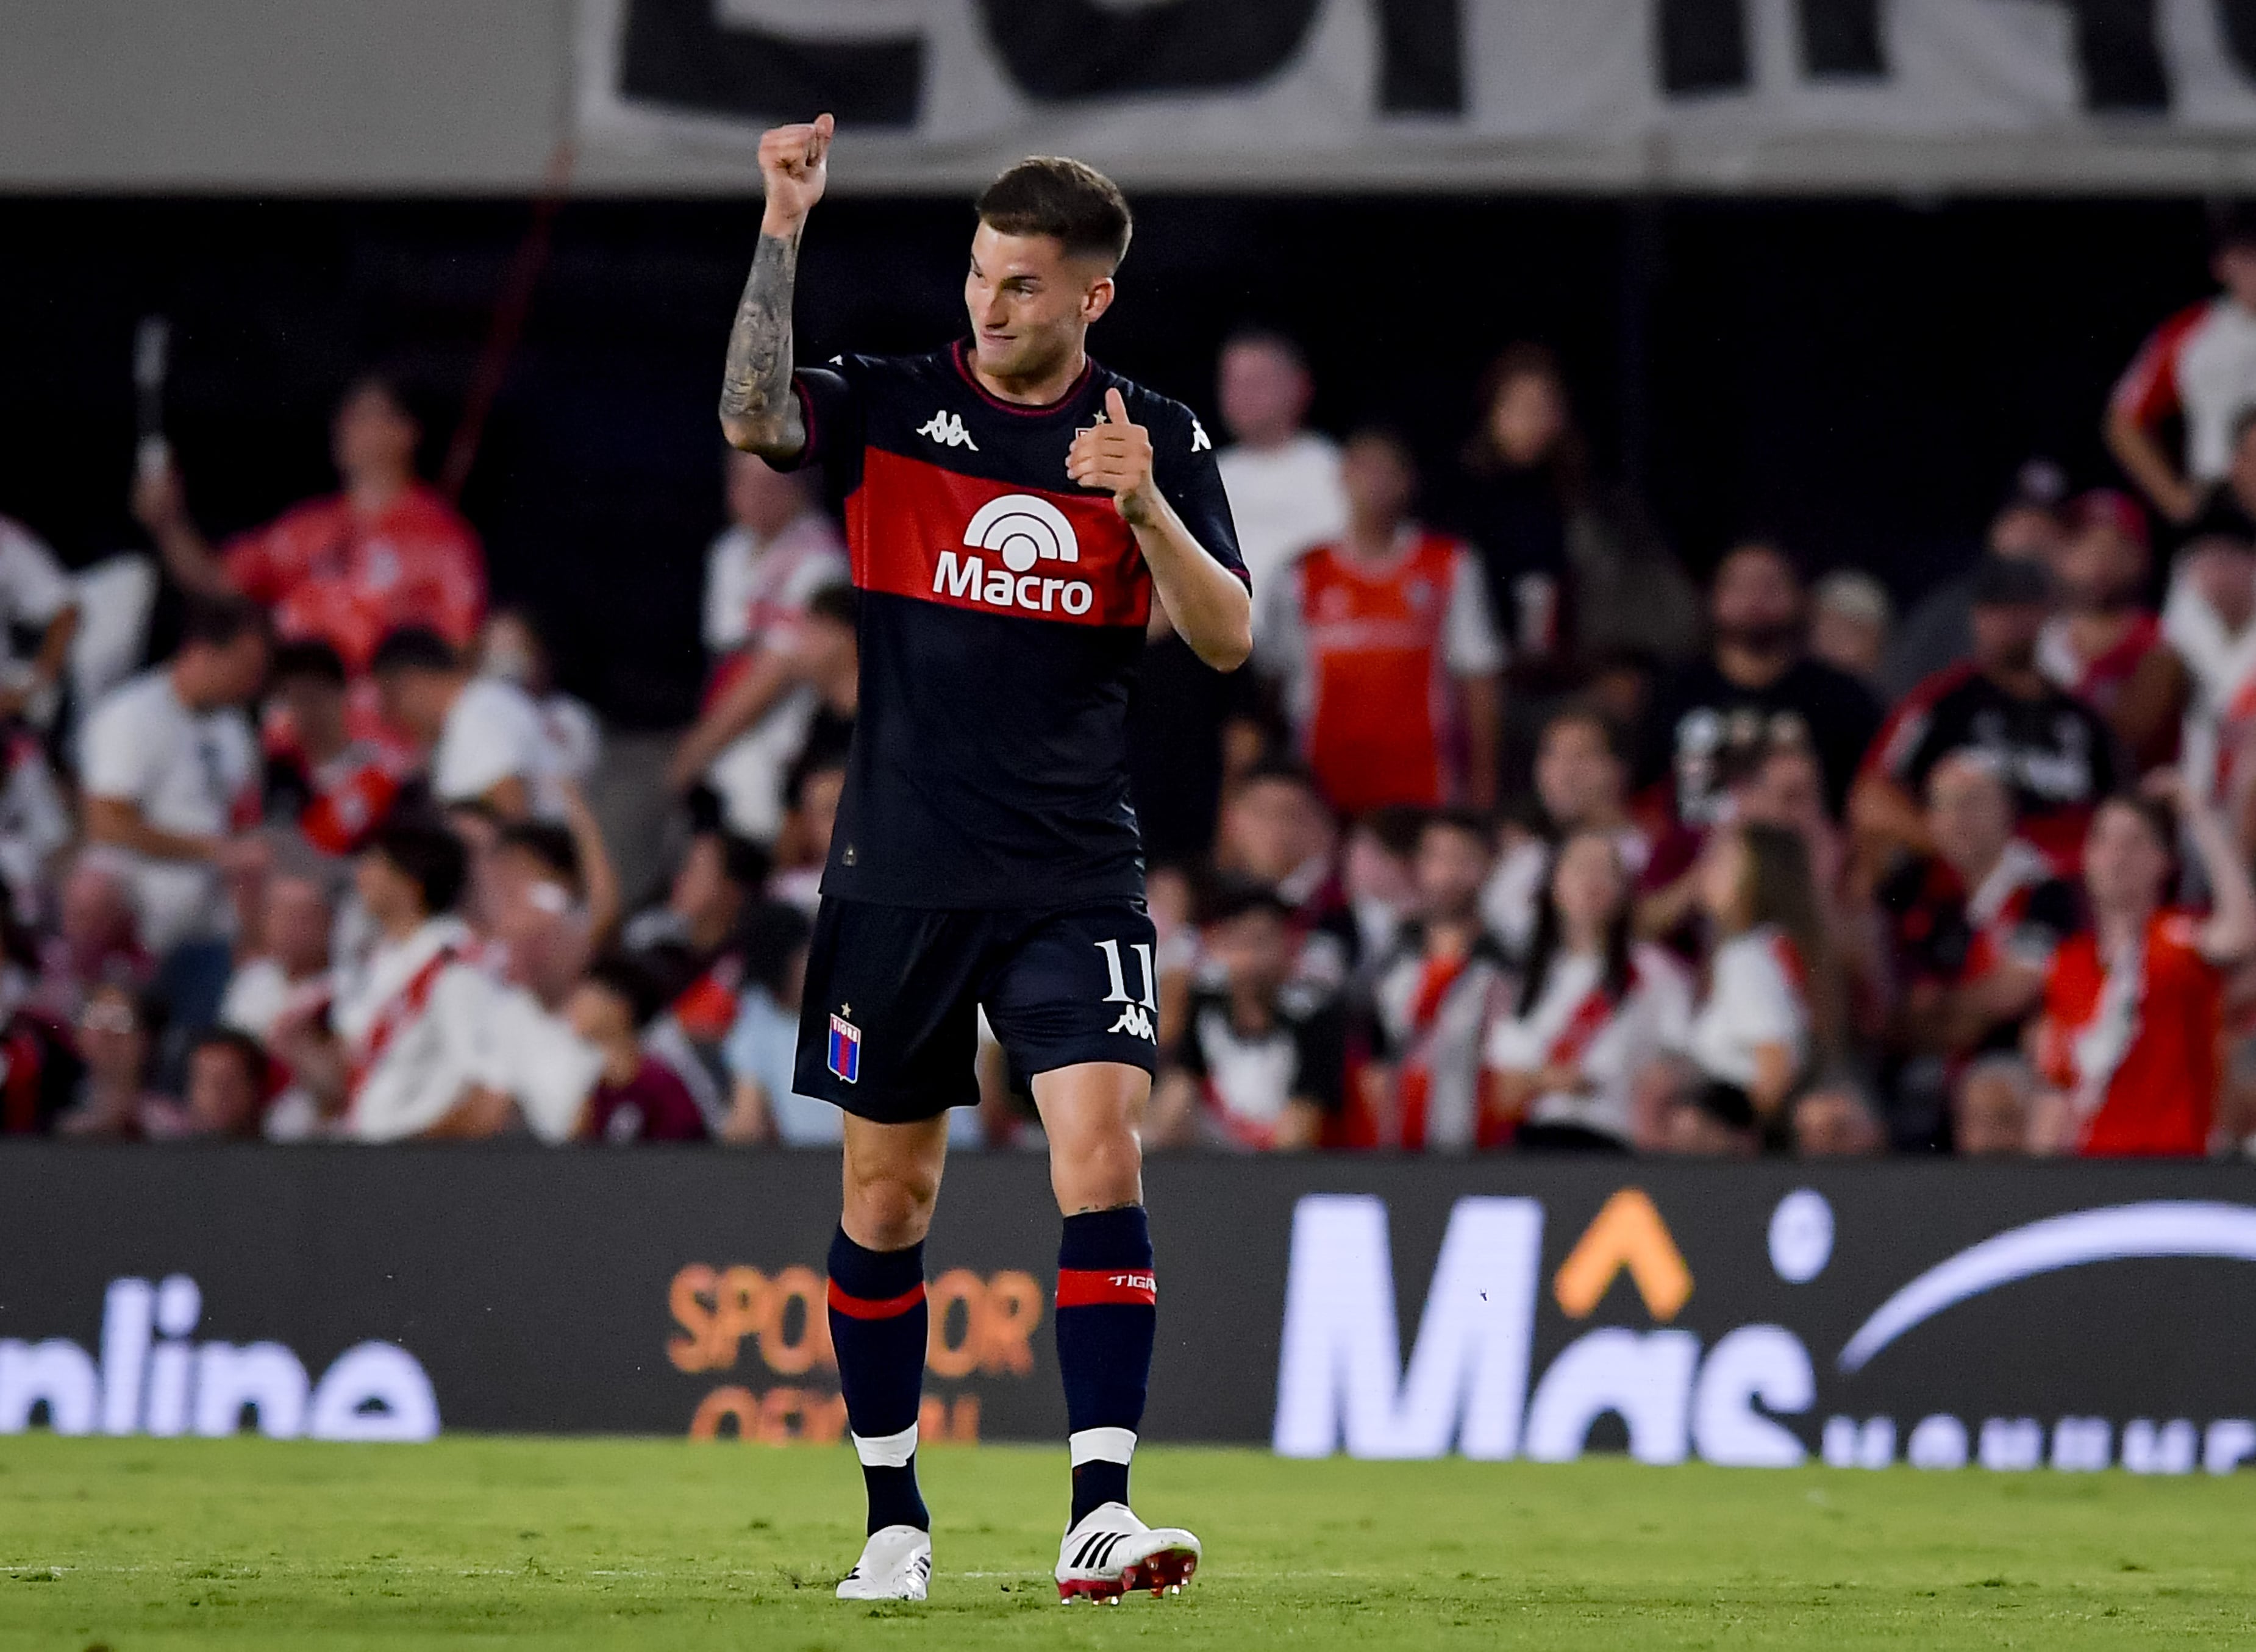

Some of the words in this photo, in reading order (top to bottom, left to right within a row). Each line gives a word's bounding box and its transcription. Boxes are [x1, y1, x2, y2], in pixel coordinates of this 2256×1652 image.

[932, 550, 1093, 615] Macro
[1094, 939, 1158, 1013] 11
[832, 1018, 857, 1042] TIGRE
[668, 1261, 1043, 1378] SPOOR
[0, 1272, 440, 1442] nline
